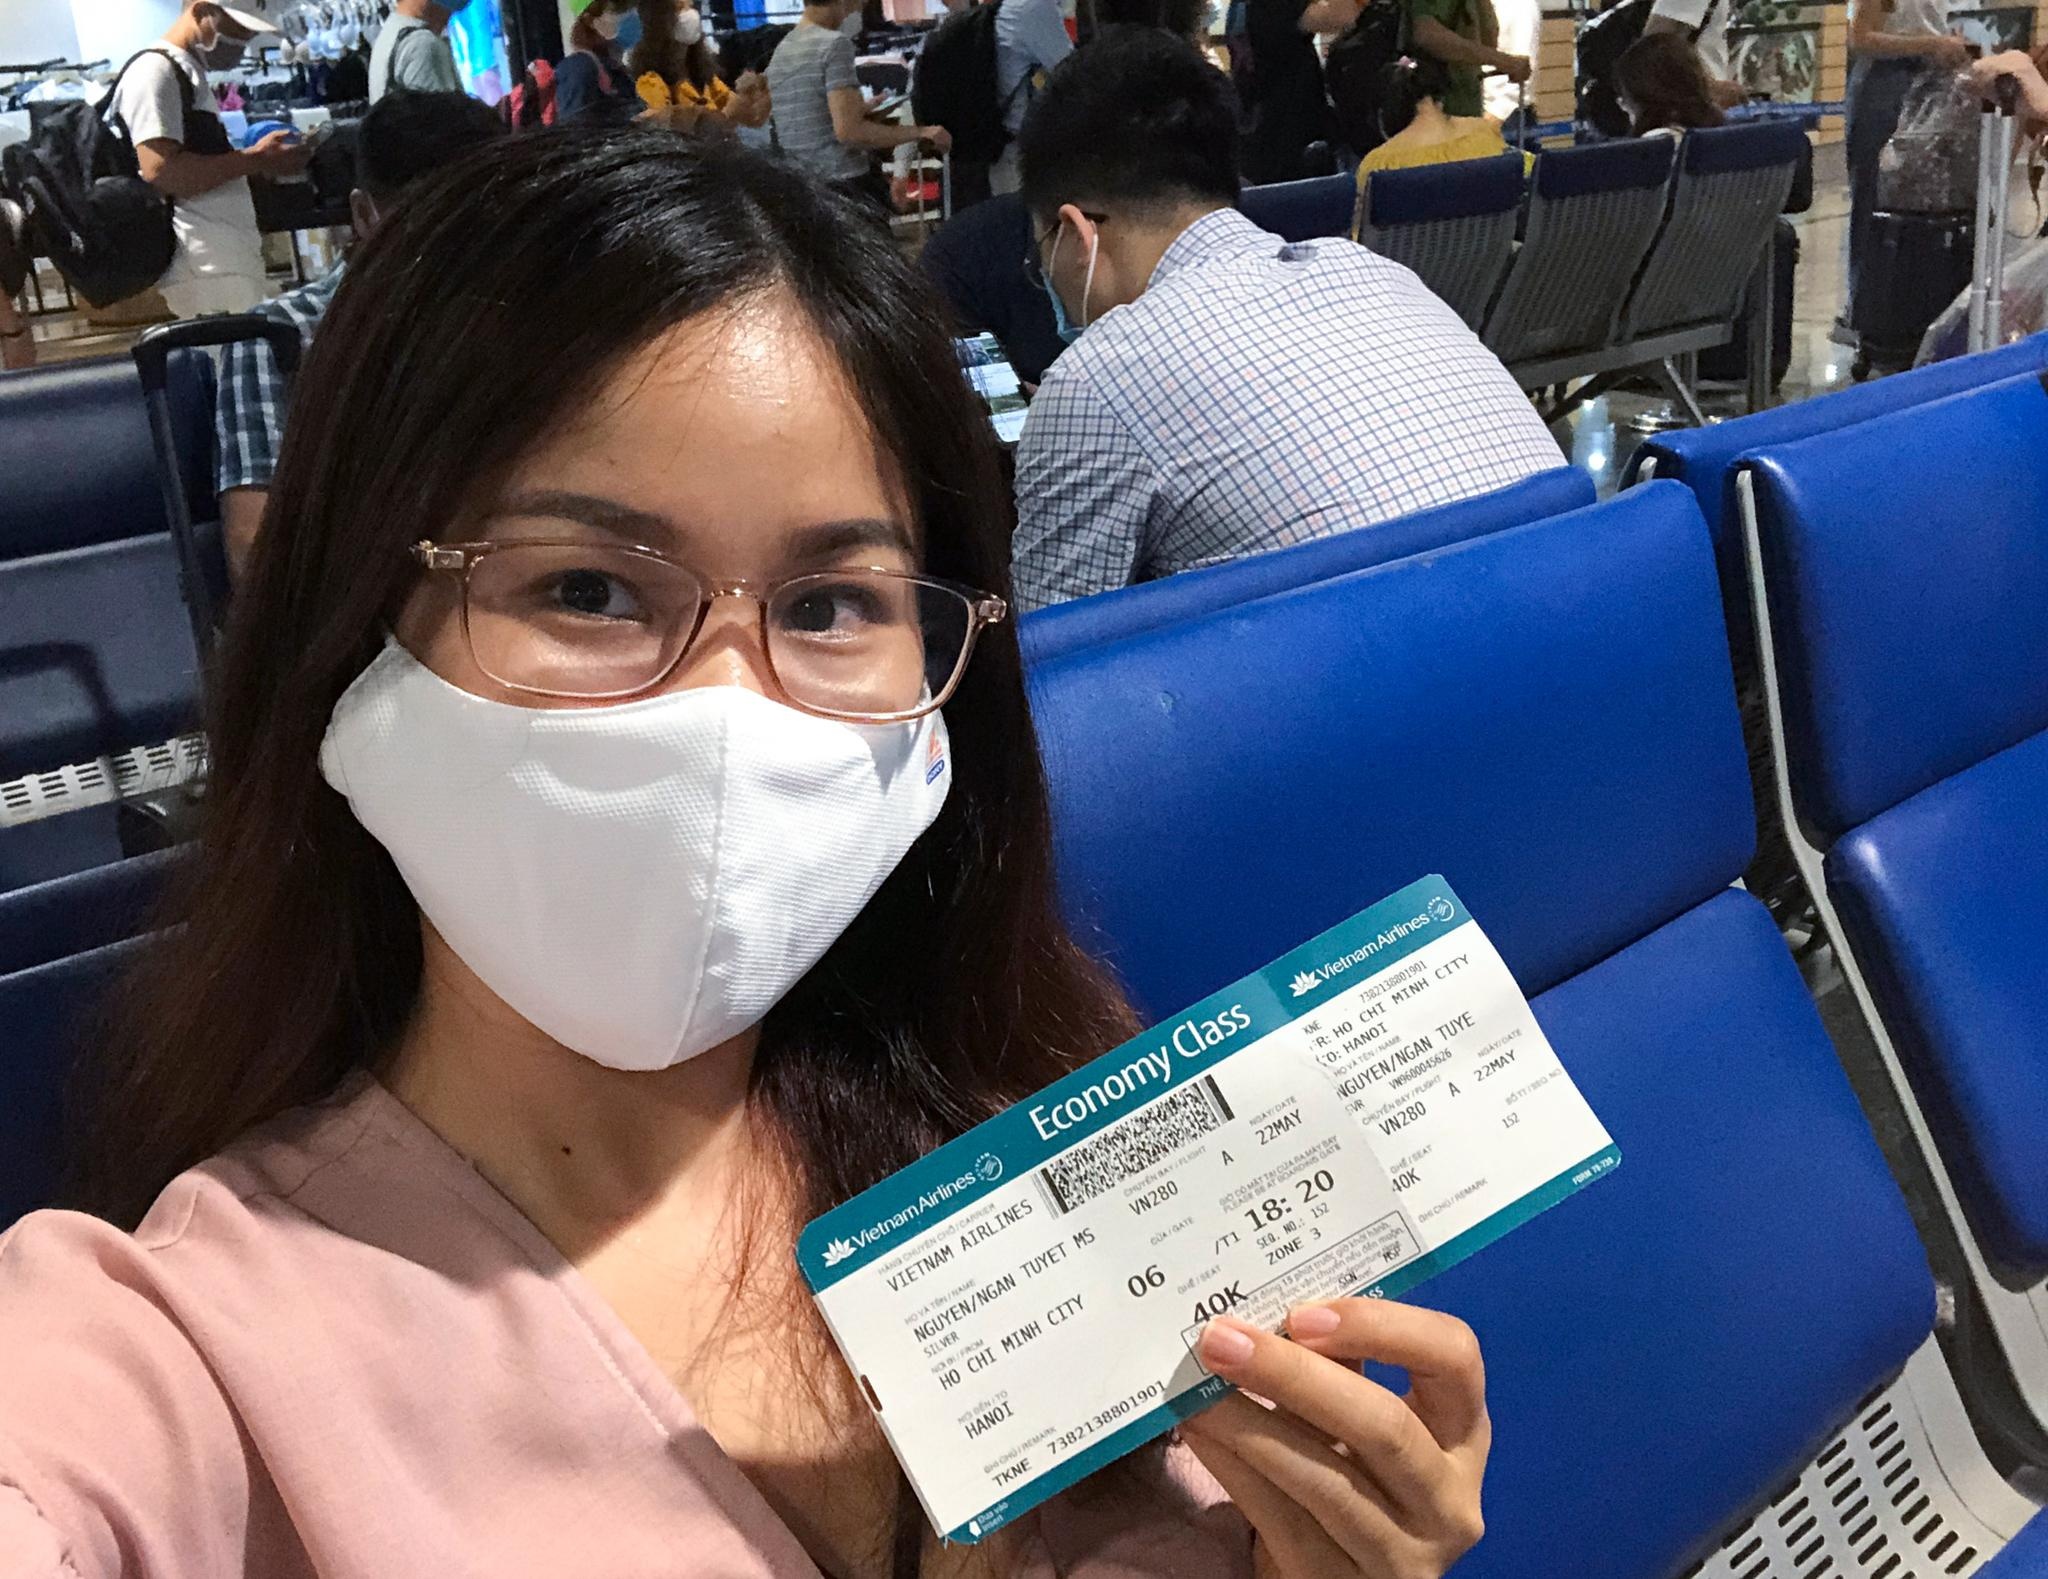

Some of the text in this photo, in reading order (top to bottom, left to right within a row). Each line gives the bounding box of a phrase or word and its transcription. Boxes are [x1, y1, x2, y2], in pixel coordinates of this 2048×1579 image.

[1315, 912, 1430, 979] Vietnam Airlines
[1331, 1020, 1353, 1038] HO
[1358, 1001, 1386, 1023] CHI
[1390, 977, 1429, 1004] MINH
[1434, 953, 1468, 979] CITY
[1434, 1010, 1475, 1040] TUYE
[1341, 1021, 1387, 1053] HANOI
[1028, 1003, 1251, 1140] Economy Class
[1377, 1048, 1515, 1136] VN280 A 22MAY
[1501, 1111, 1519, 1128] 152
[1128, 1108, 1302, 1215] VN280 A 22MAY
[850, 1171, 976, 1248] Vietnam Airlines
[1243, 1169, 1334, 1231] 18: 20
[1255, 1232, 1280, 1249] SEQ.
[1310, 1201, 1329, 1219] 152
[886, 1198, 1032, 1292] VIETNAM AIRLINES
[1127, 1230, 1240, 1297] 06 /T1
[1265, 1226, 1323, 1265] ZONE 3
[913, 1227, 1095, 1342] NGUYEN/NGAN TUYET MS
[1193, 1279, 1248, 1325] 40K
[923, 1330, 959, 1357] SILVER
[938, 1293, 1083, 1390] HO CHI MINH CITY
[964, 1400, 1013, 1439] HANOI
[991, 1380, 1171, 1486] TKNE 7382138801901
